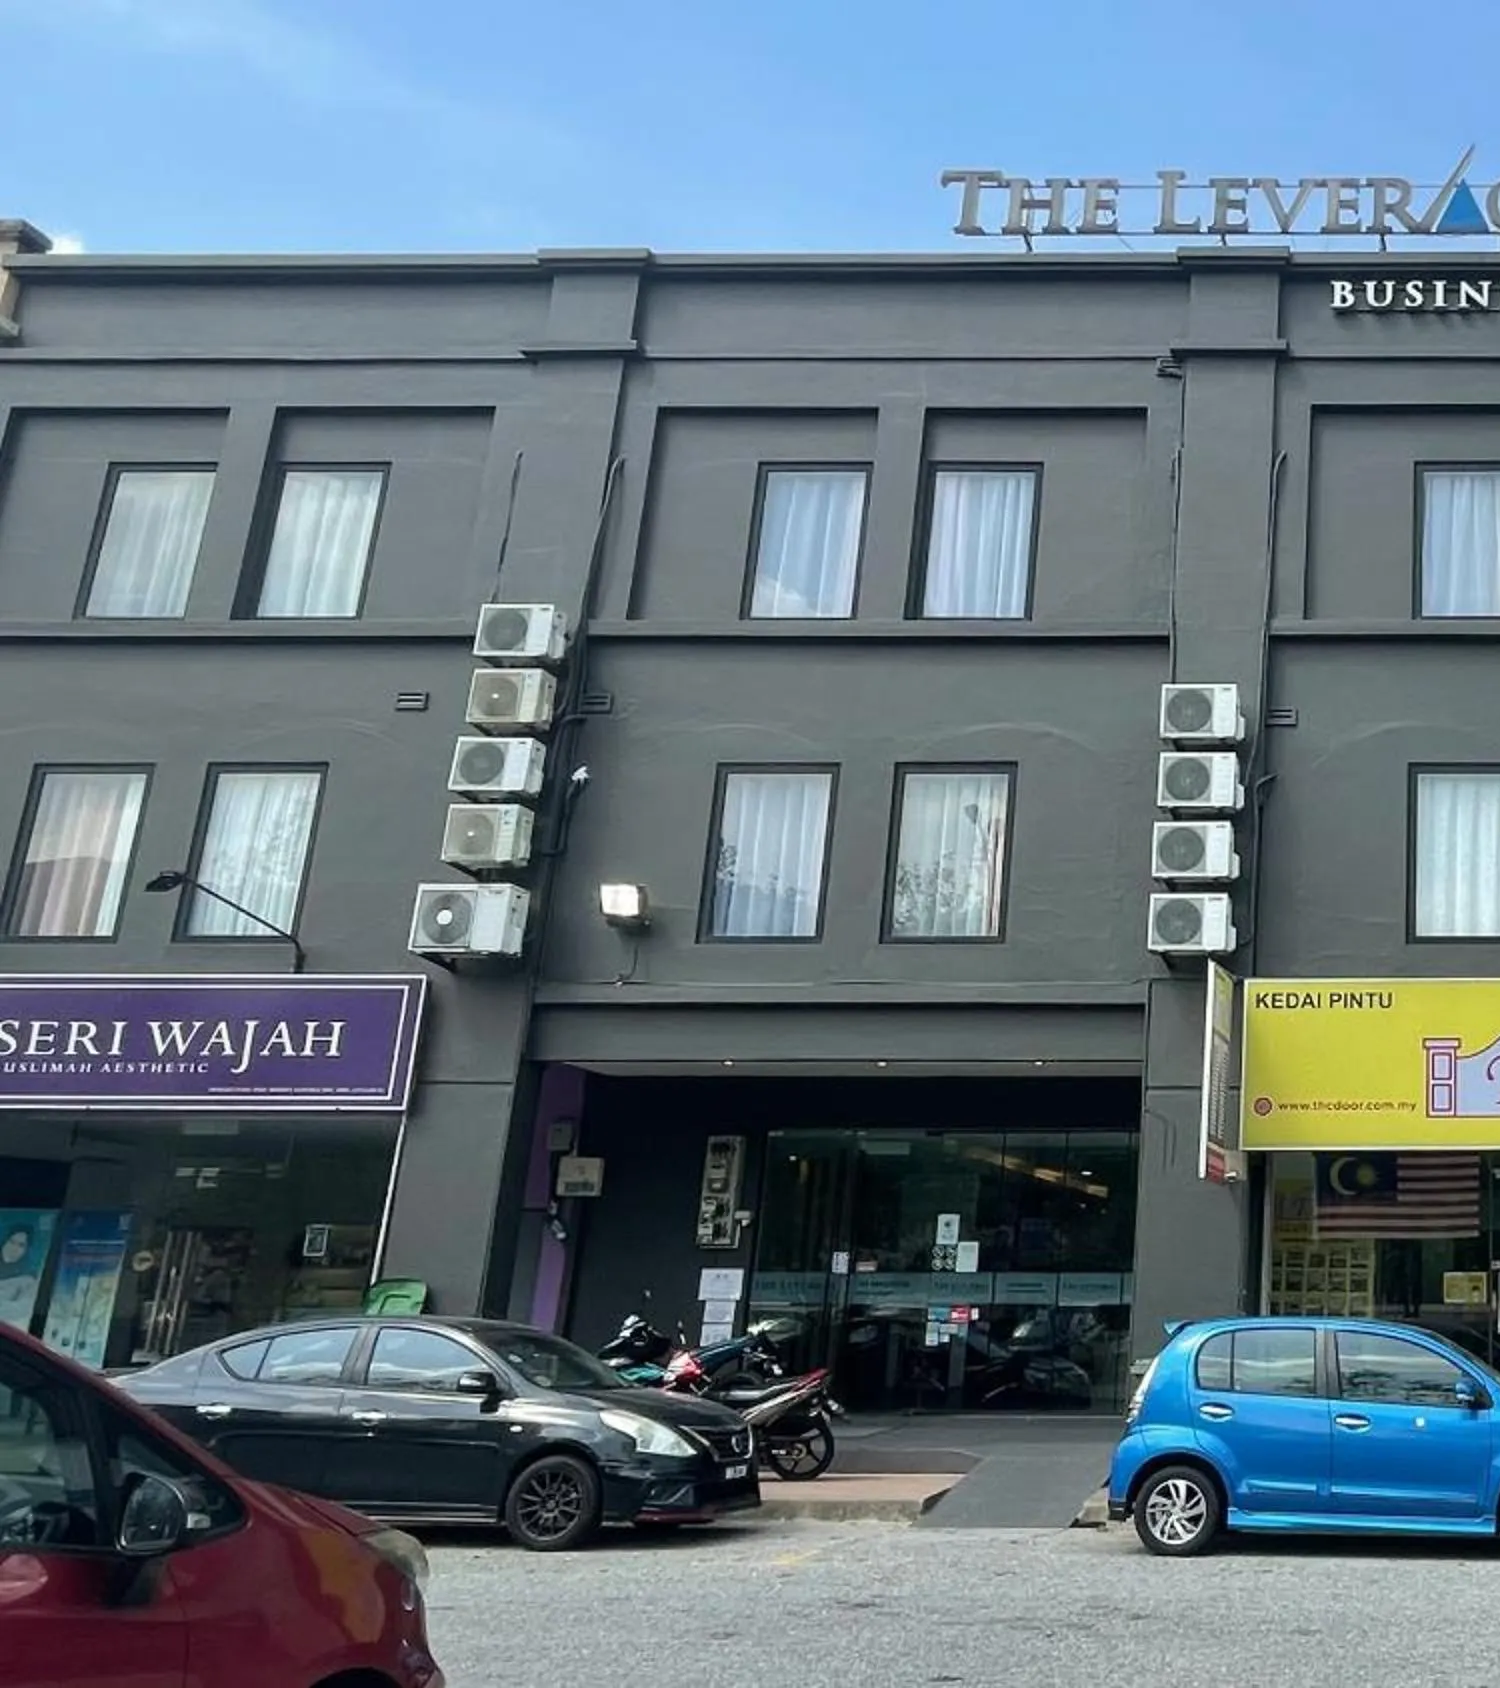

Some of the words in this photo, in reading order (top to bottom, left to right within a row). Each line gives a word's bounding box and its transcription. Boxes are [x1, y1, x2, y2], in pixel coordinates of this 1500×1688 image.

[941, 170, 1119, 235] THE
[1255, 992, 1322, 1009] KEDAI
[1329, 992, 1393, 1009] PINTU
[0, 1019, 127, 1056] SERI
[147, 1020, 346, 1073] WAJAH
[3, 1062, 92, 1073] USLIMAH
[101, 1062, 209, 1073] AESTHETIC
[1278, 1101, 1416, 1112] www.thcdoor.com.my
